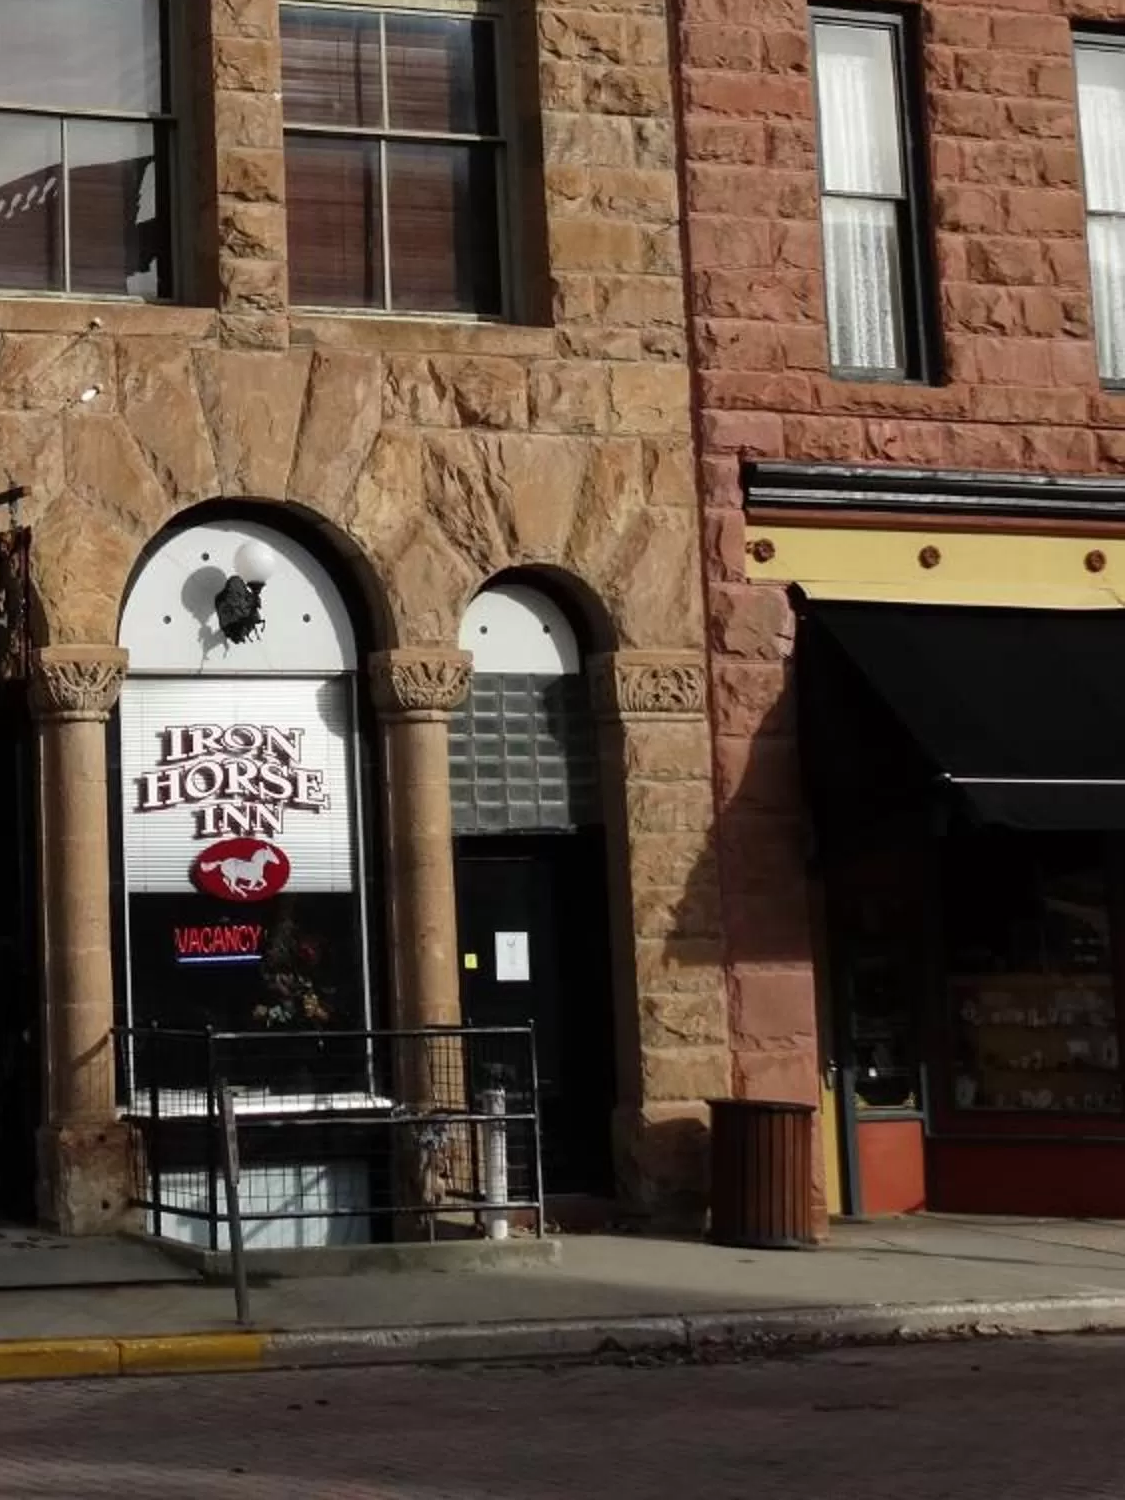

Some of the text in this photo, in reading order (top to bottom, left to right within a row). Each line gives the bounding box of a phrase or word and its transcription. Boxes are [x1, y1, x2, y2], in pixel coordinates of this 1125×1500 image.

[164, 725, 304, 764] IRON
[140, 760, 330, 812] HORSE
[200, 802, 284, 835] INN
[174, 927, 262, 952] VACANCY
